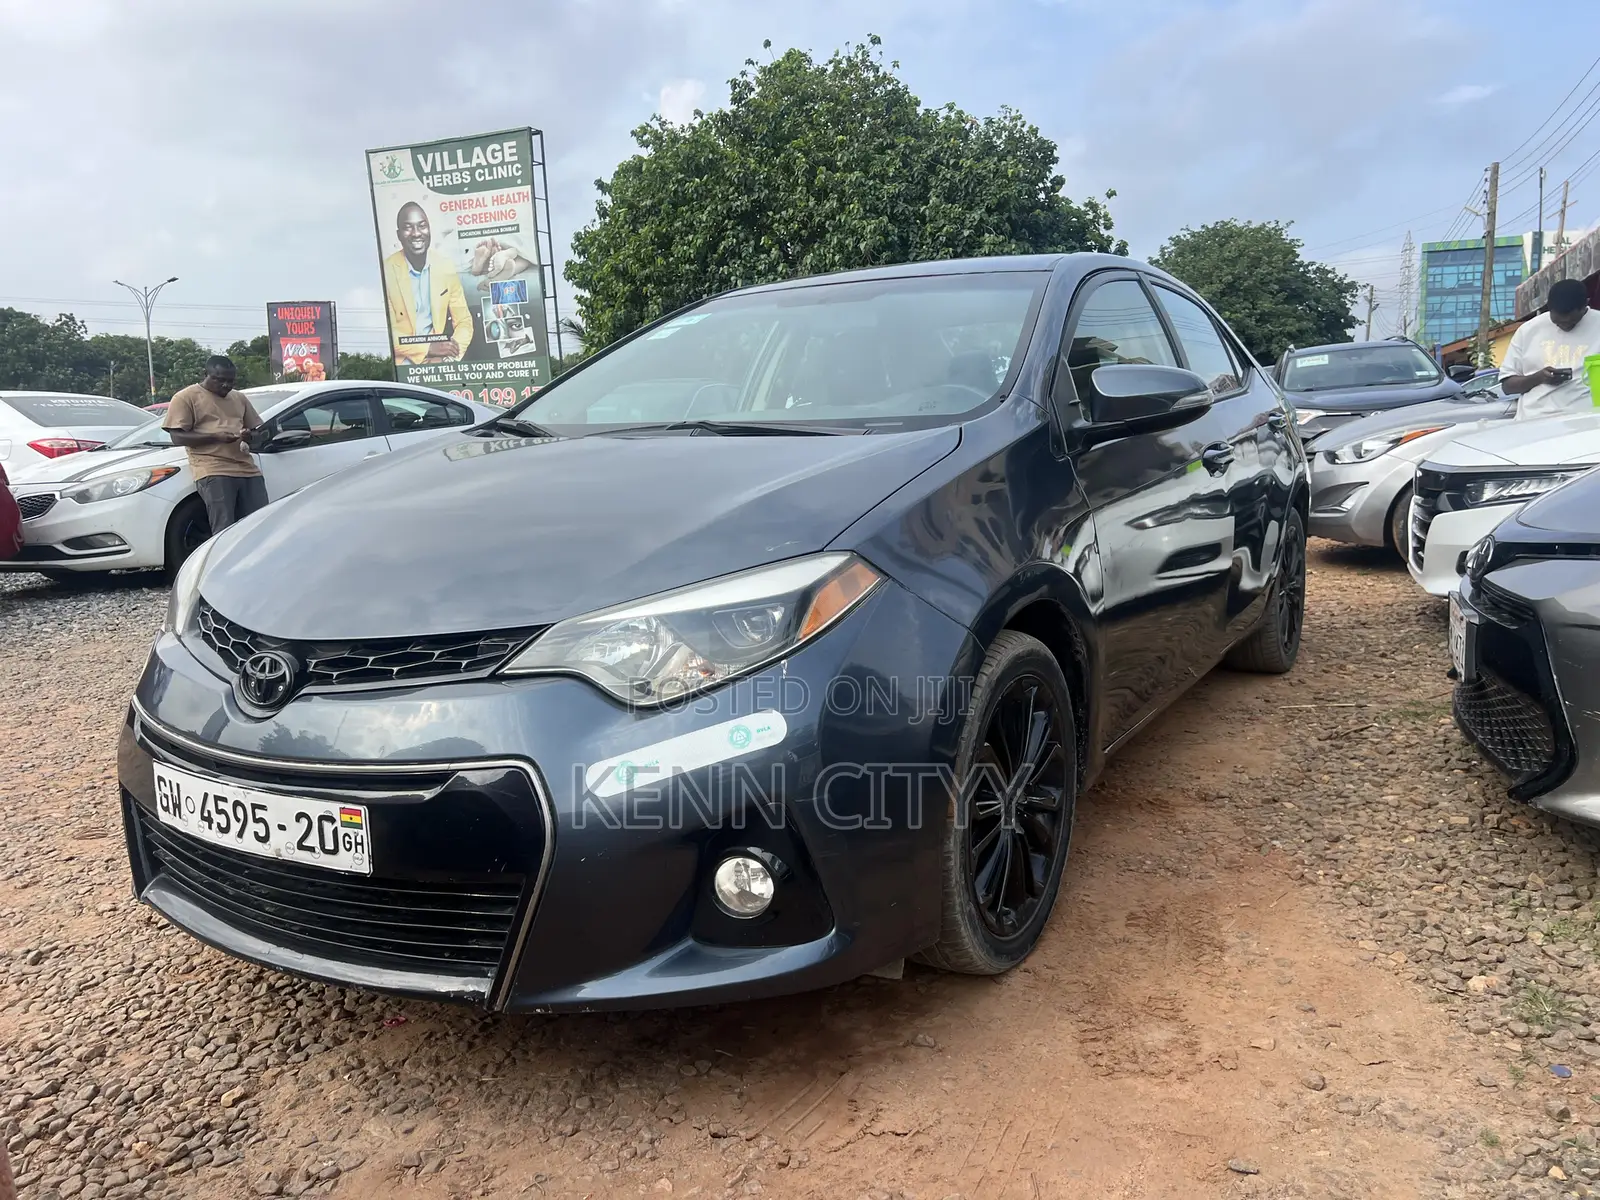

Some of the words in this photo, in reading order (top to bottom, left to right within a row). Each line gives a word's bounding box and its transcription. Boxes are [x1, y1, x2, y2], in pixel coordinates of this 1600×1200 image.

[417, 141, 518, 173] VILLAGE
[422, 171, 471, 187] HERBS
[475, 163, 522, 181] CLINIC
[440, 197, 487, 212] GENERAL
[491, 191, 530, 206] HEALTH
[456, 209, 517, 225] SCREENING
[278, 307, 320, 320] UNIQUELY
[286, 321, 315, 335] YOURS
[409, 367, 435, 375] DON'T
[471, 363, 495, 371] YOUR
[497, 360, 536, 370] PROBLEM
[423, 374, 442, 382] WILL
[445, 373, 463, 381] TELL
[464, 372, 482, 380] YOU
[485, 370, 504, 379] AND
[507, 369, 529, 377] CURE
[479, 387, 516, 406] 199
[157, 775, 182, 819] GW
[342, 832, 364, 854] GH
